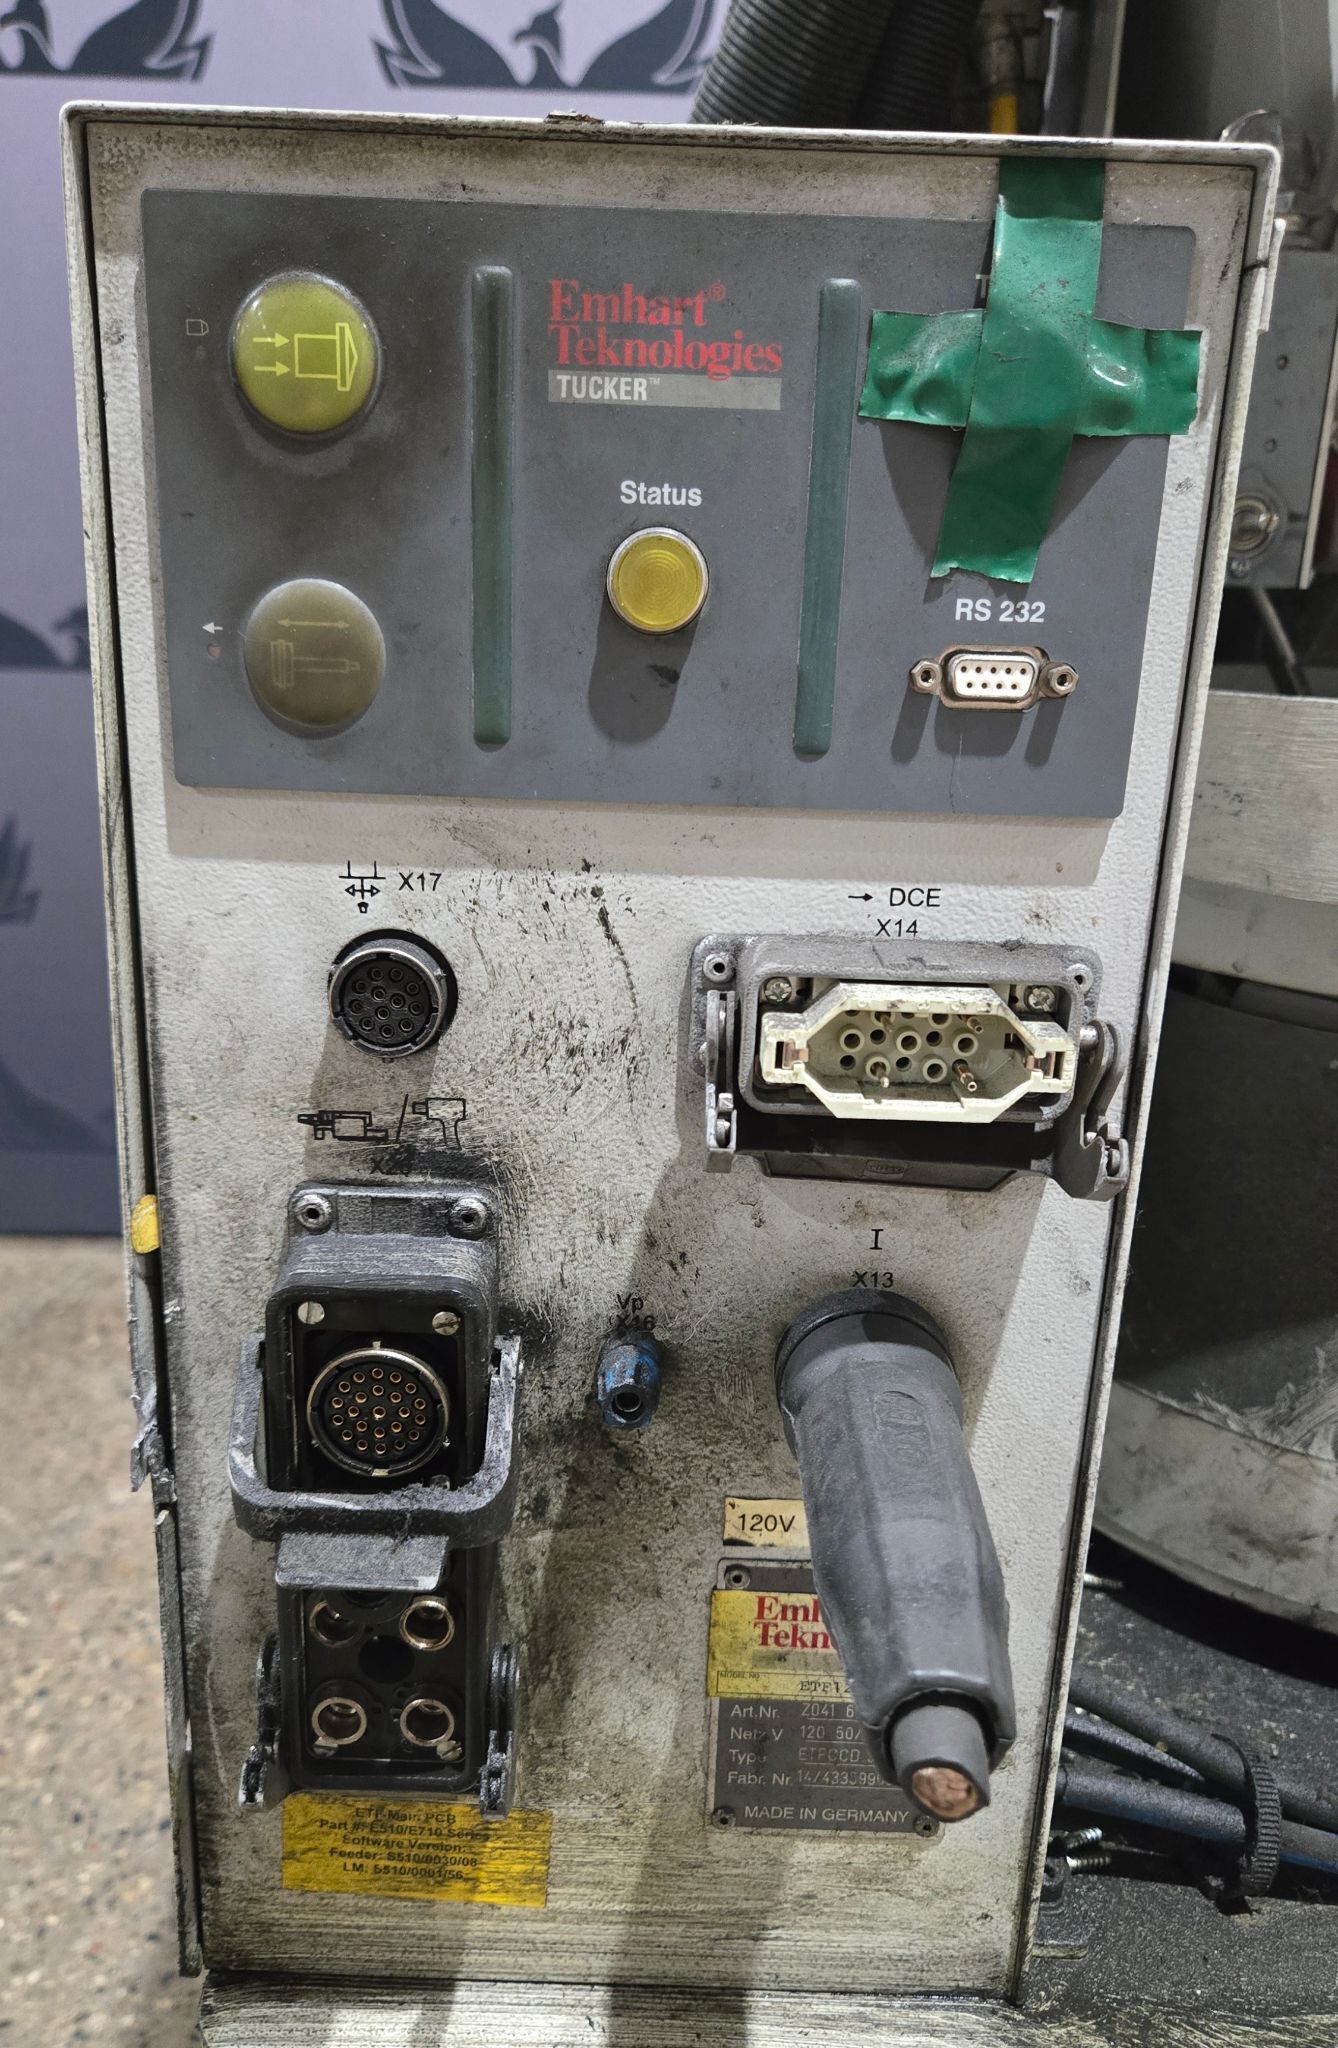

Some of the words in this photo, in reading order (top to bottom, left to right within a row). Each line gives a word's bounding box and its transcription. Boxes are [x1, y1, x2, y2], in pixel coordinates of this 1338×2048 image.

[550, 323, 783, 382] Teknologies
[620, 480, 702, 506] Status
[955, 598, 991, 622] RS
[999, 600, 1046, 623] 232
[398, 871, 442, 892] X17
[889, 887, 941, 907] DCE
[875, 918, 918, 938] X14
[852, 1270, 894, 1288] X13
[616, 1293, 644, 1314] Vp
[737, 1513, 795, 1533] 120V
[753, 1621, 838, 1649] Tekn
[772, 1728, 784, 1741] V
[800, 1725, 826, 1738] 120
[728, 1771, 766, 1786] Fabr.
[772, 1774, 793, 1787] Nr.
[319, 1819, 349, 1831] Part
[745, 1806, 794, 1818] MADE
[800, 1808, 817, 1820] IN
[821, 1808, 910, 1824] GERMANY
[342, 1834, 404, 1849] Software
[329, 1847, 382, 1860] Feeder:
[342, 1861, 368, 1874] LM:
